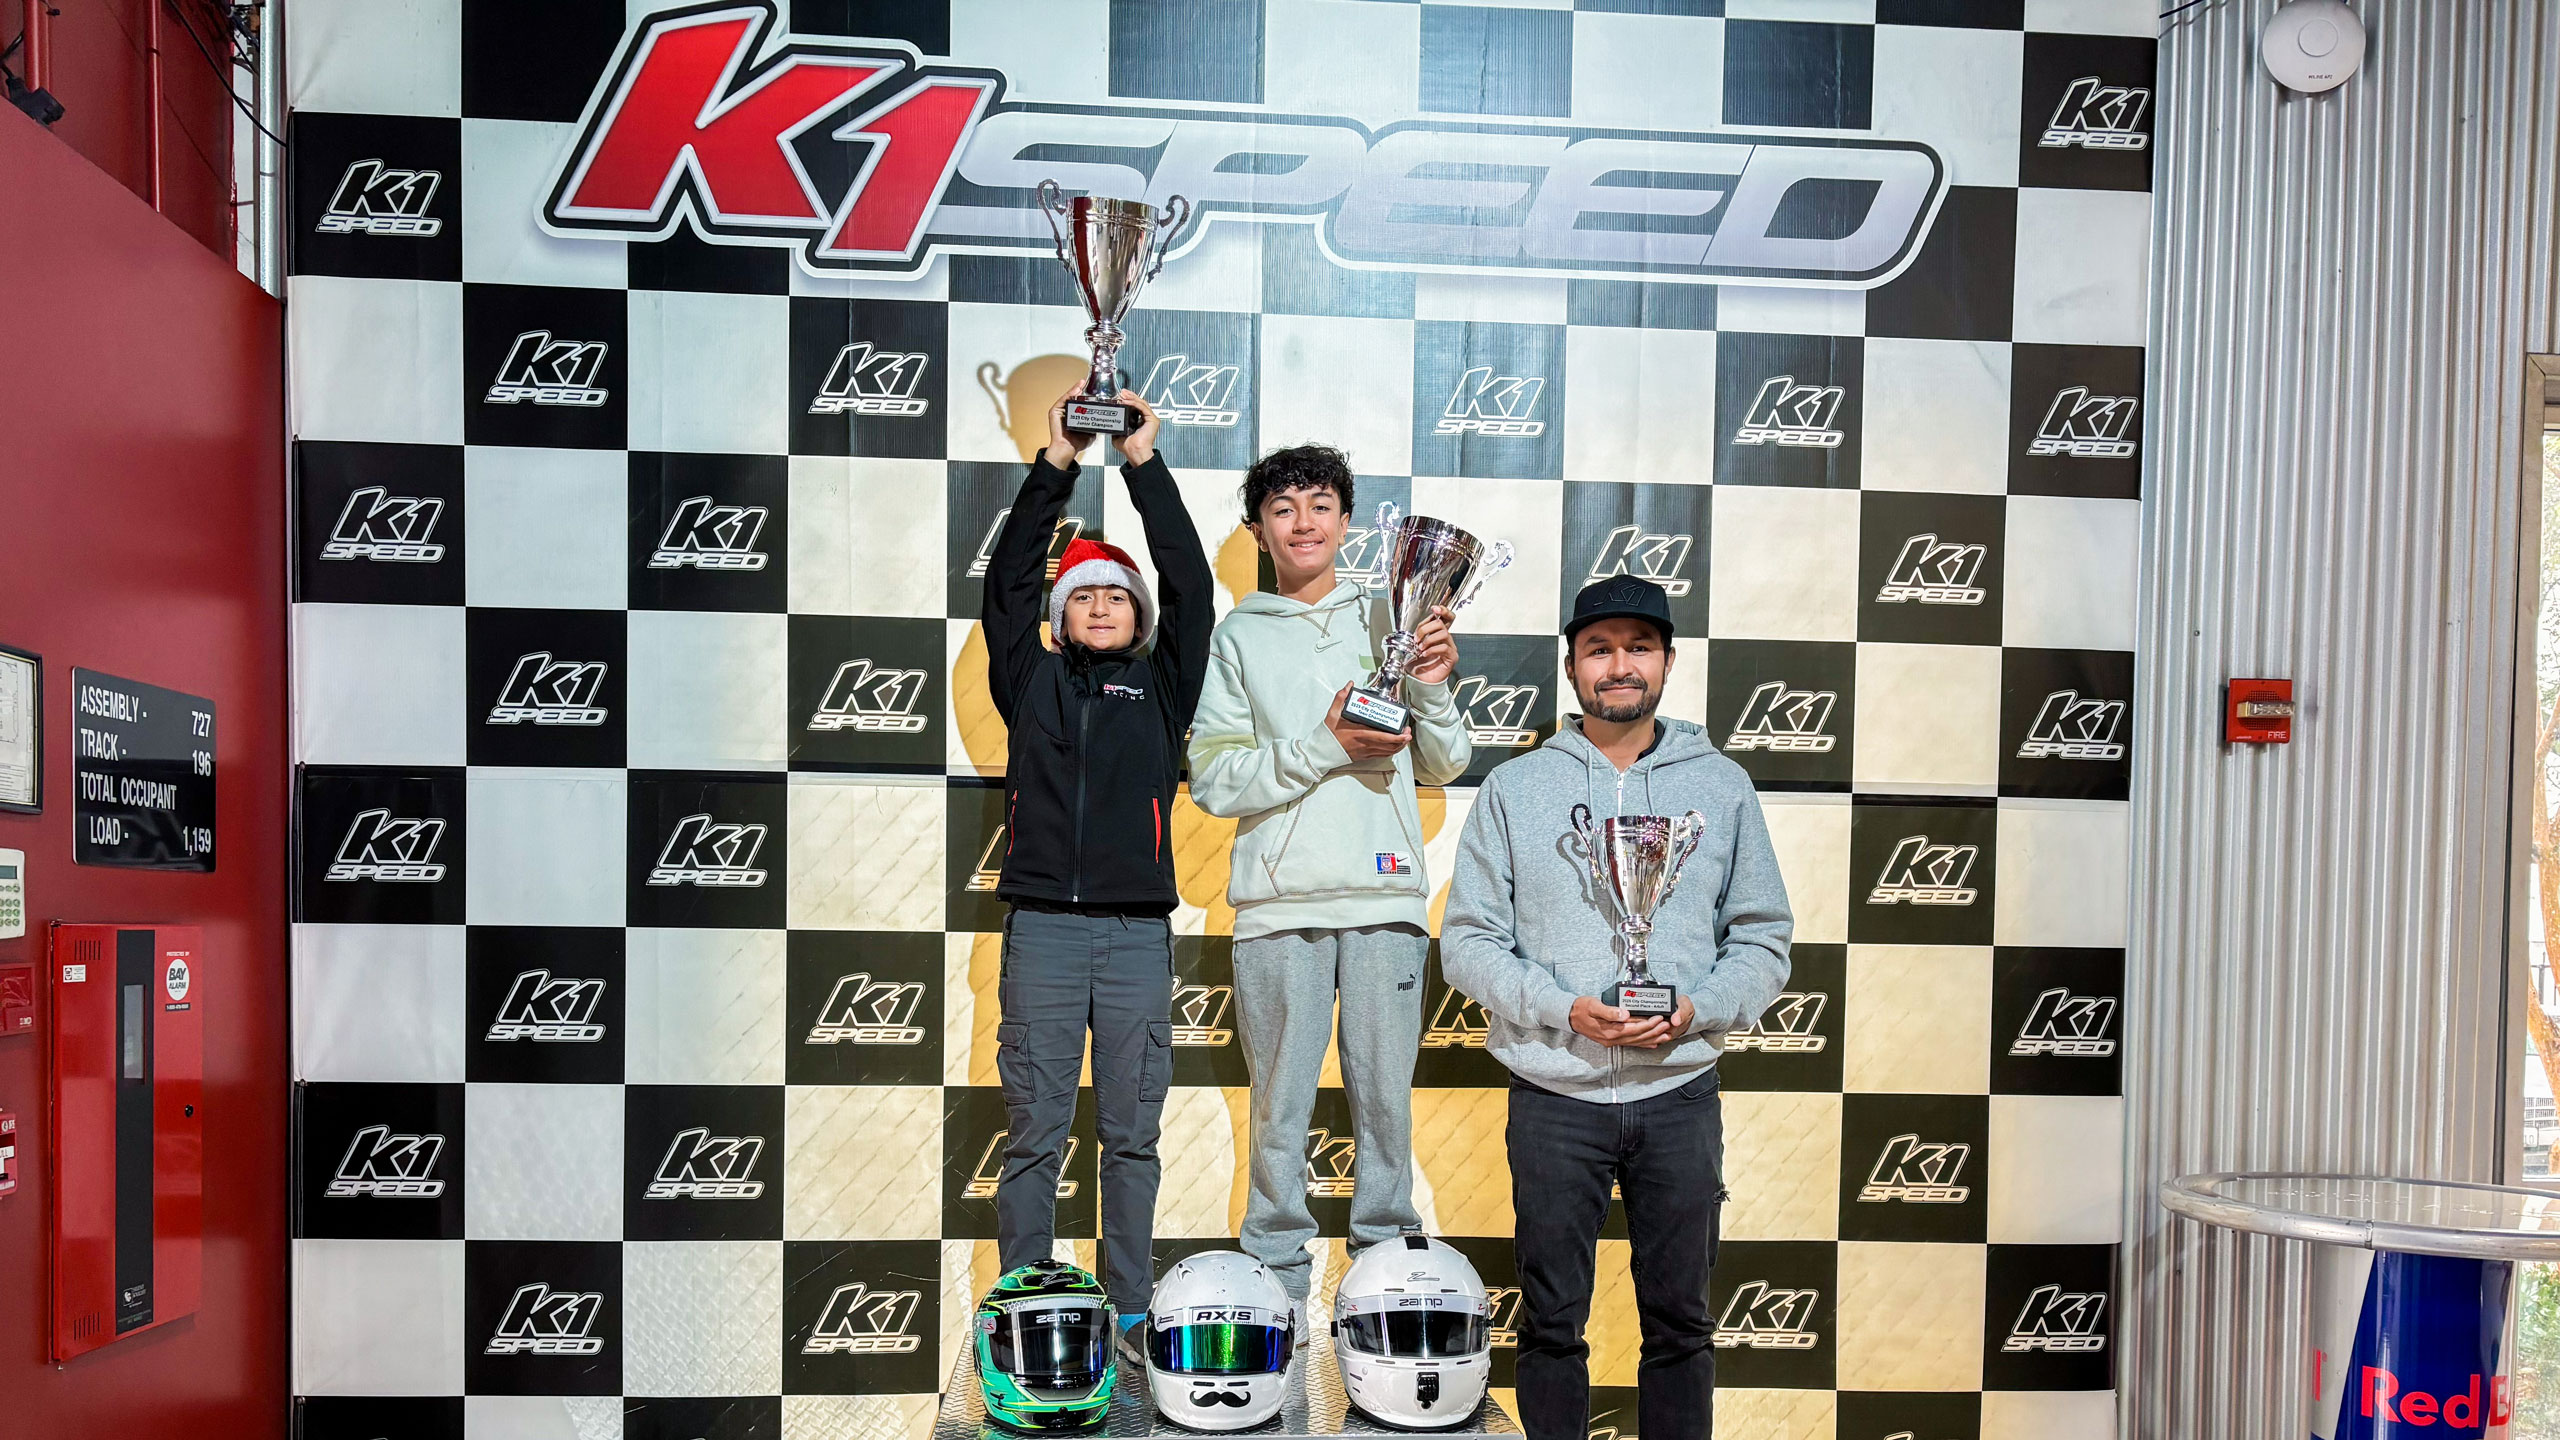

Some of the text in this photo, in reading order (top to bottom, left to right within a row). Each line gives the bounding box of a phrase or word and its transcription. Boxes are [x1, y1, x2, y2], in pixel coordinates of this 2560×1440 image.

[2050, 78, 2149, 132] K1
[550, 3, 1918, 272] K1 SPEED
[2040, 131, 2148, 149] SPEED
[328, 160, 440, 217] K1
[318, 216, 441, 235] SPEED
[497, 331, 606, 388] K1
[820, 343, 927, 398] K1
[1138, 355, 1240, 409] K1
[486, 387, 607, 406] SPEED
[1443, 366, 1545, 419] K1
[810, 398, 927, 415] SPEED
[1744, 377, 1844, 430] K1
[2038, 387, 2137, 440] K1
[1091, 416, 1121, 424] Championship
[1152, 410, 1240, 426] PEED
[1434, 420, 1545, 436] SPEED
[1731, 429, 1843, 447] SPEED
[2028, 440, 2136, 457] SPEED
[332, 487, 443, 544] K1
[659, 497, 767, 552] K1
[322, 543, 444, 561] SPEED
[650, 552, 767, 569] SPEED
[1590, 526, 1692, 578] K1
[1887, 535, 1986, 587] K1
[1877, 587, 1985, 604] SPEED
[498, 653, 606, 707] K1
[819, 660, 926, 715] K1
[1104, 690, 1145, 701] RACING
[1452, 677, 1538, 729] K1
[80, 685, 139, 723] ASSEMBLY
[191, 710, 212, 737] 727
[488, 708, 606, 724] SPEED
[1735, 682, 1836, 735] K1
[2028, 691, 2125, 743] K1
[809, 714, 926, 734] SPEED
[1467, 730, 1537, 745] EED
[1722, 735, 1835, 751] SPEED
[2267, 731, 2287, 739] FIRE
[80, 728, 119, 761] TRACK
[192, 750, 212, 777] 196
[2018, 742, 2124, 759] SPEED
[80, 771, 177, 811] TOTAL OCCUPANT
[90, 816, 121, 845] LOAD
[182, 826, 212, 856] 1,159
[336, 809, 445, 864] K1
[658, 815, 766, 869] K1
[1878, 836, 1977, 888] K1
[326, 865, 445, 881] SPEED
[648, 869, 766, 886] SPEED
[1869, 885, 1976, 905] SPEED
[168, 967, 187, 981] BAY
[497, 970, 604, 1024] K1
[817, 974, 924, 1027] K1
[1430, 986, 1490, 1031] K
[2020, 988, 2116, 1039] K1
[487, 1025, 604, 1041] SPEED
[807, 1028, 924, 1043] SPEED
[1172, 1031, 1232, 1045] EED
[1420, 1033, 1488, 1046] SPE
[1723, 1036, 1826, 1051] SPEED
[2010, 1040, 2115, 1055] SPEED
[336, 1126, 444, 1180] K1
[656, 1128, 763, 1182] K1
[1869, 1135, 1969, 1186] K1
[326, 1181, 444, 1197] SPEED
[645, 1183, 763, 1198] SPEED
[1859, 1183, 1969, 1202] SPEED
[496, 1284, 602, 1337] K1
[814, 1283, 920, 1336] K1
[1398, 1298, 1443, 1309] zamp
[1718, 1281, 1817, 1332] K1
[2012, 1285, 2106, 1335] K1
[1035, 1312, 1081, 1324] zamp
[1195, 1311, 1252, 1323] AXIS
[486, 1338, 603, 1354] SPEED
[804, 1337, 920, 1353] SPEED
[1710, 1332, 1817, 1349] SPEED
[2003, 1337, 2105, 1351] SPEED
[2360, 1365, 2481, 1429] Red
